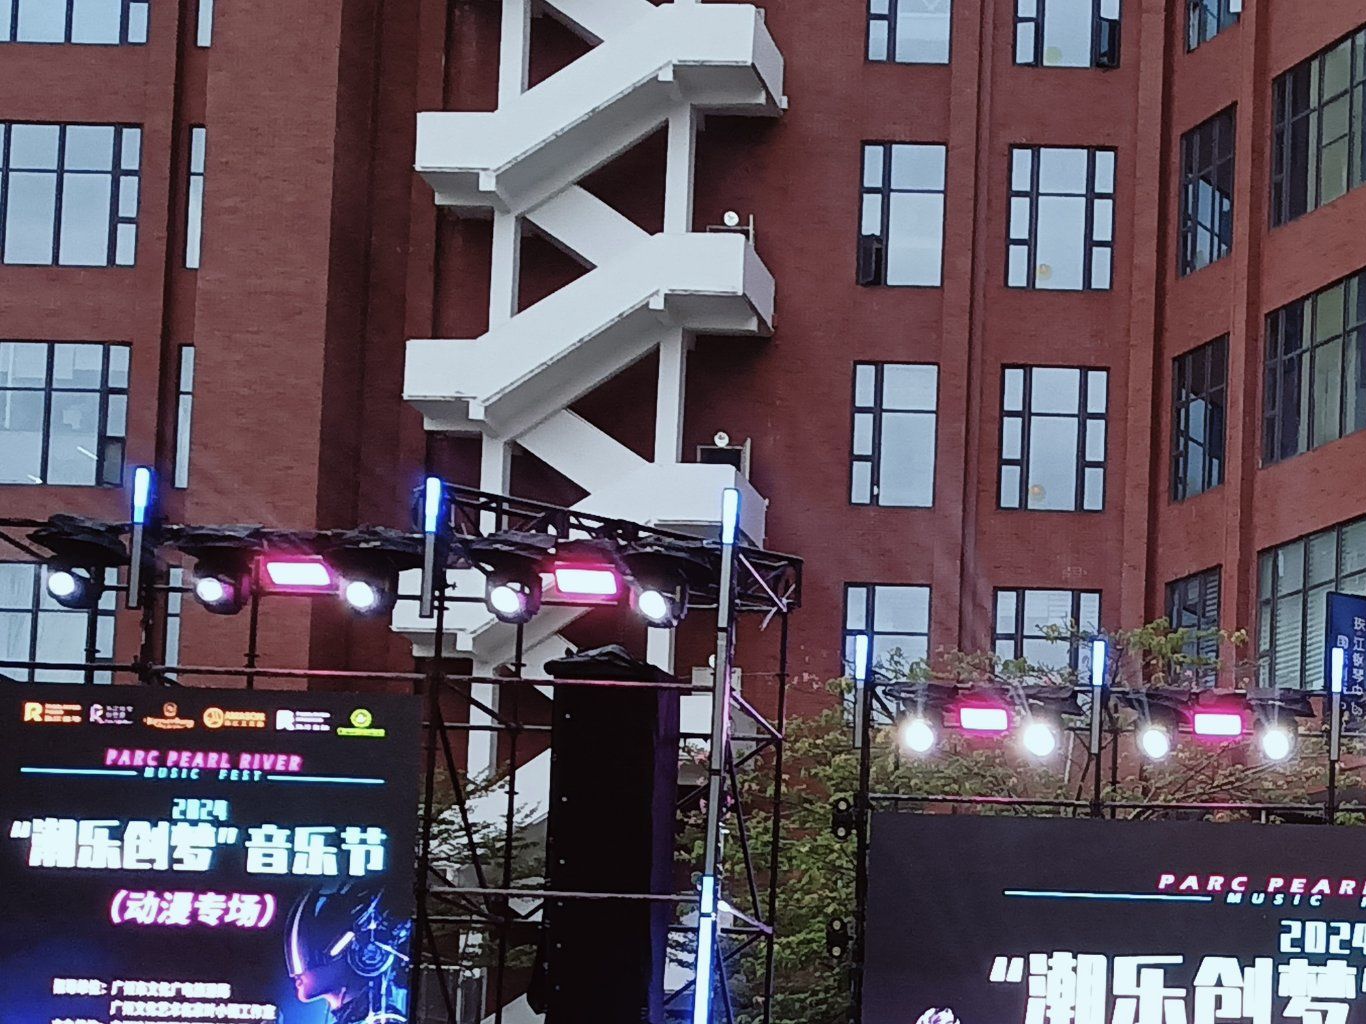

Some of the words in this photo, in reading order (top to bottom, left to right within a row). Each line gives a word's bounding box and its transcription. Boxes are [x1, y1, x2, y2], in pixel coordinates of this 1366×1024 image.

[105, 749, 159, 767] PARC
[166, 751, 231, 769] PEARL
[239, 754, 302, 772] RIVER
[143, 767, 200, 779] MUSIC
[218, 769, 263, 782] FEST
[172, 799, 228, 820] 2024
[1158, 875, 1248, 892] PARC
[1226, 892, 1322, 906] MUSIC
